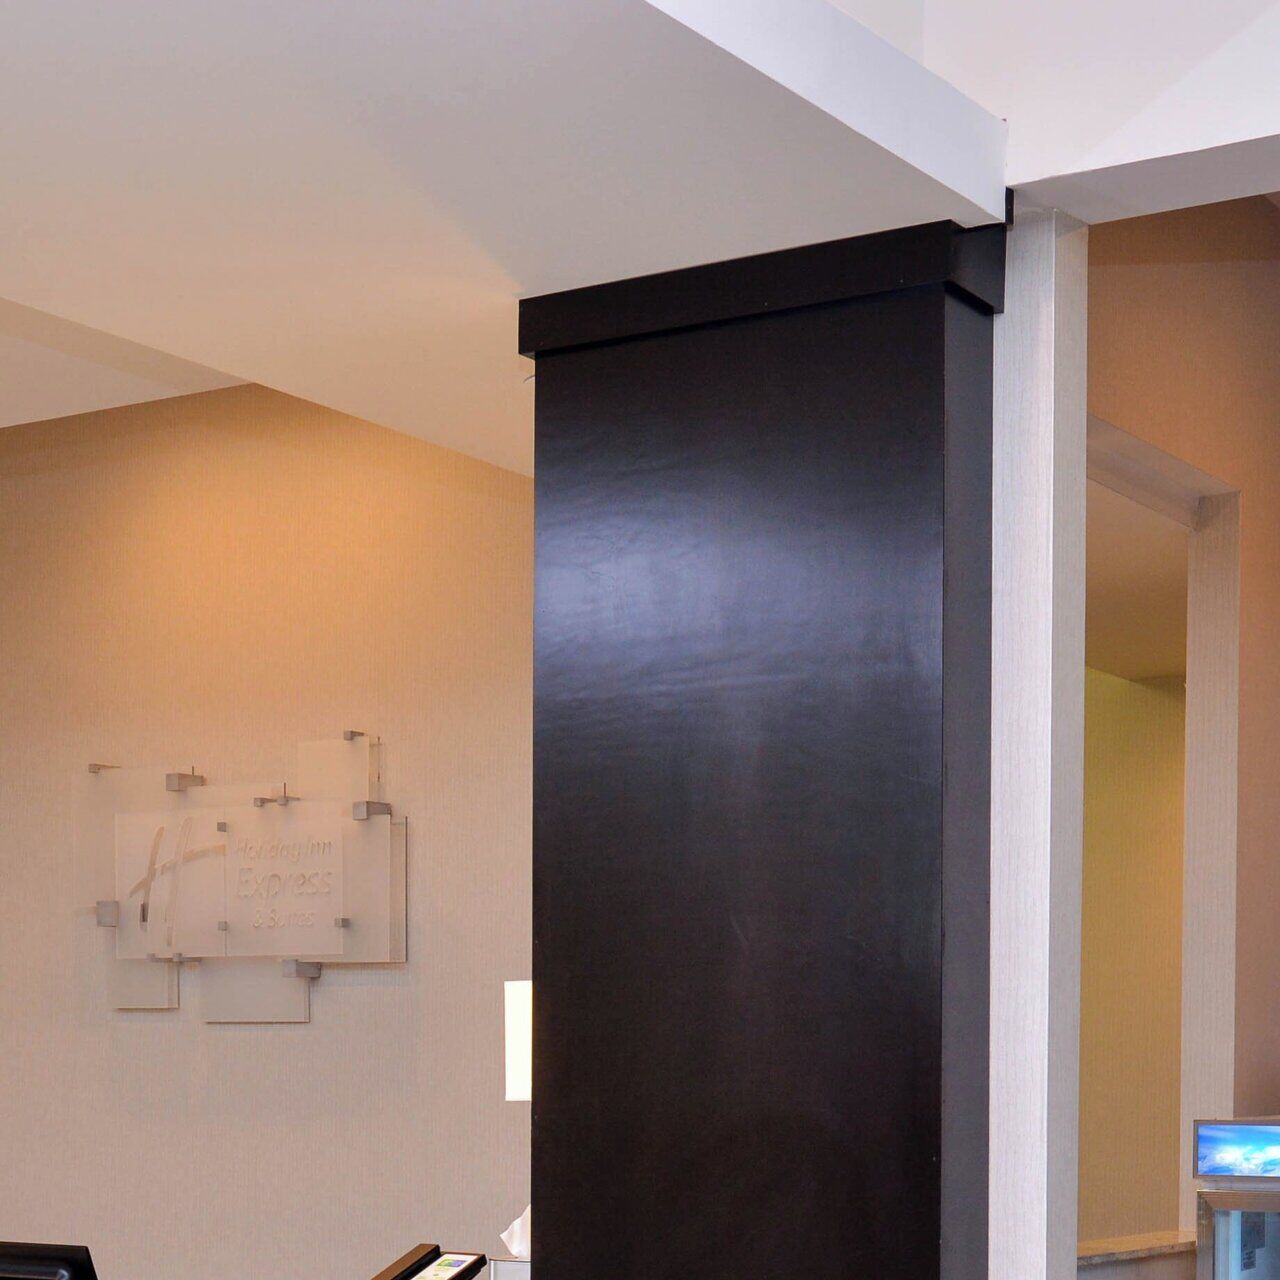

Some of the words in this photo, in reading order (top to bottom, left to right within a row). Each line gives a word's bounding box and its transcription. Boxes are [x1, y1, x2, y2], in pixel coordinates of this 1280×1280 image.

[236, 838, 300, 863] Holiday
[307, 838, 333, 856] Inn
[238, 867, 332, 899] Express
[268, 908, 315, 928] Suites
